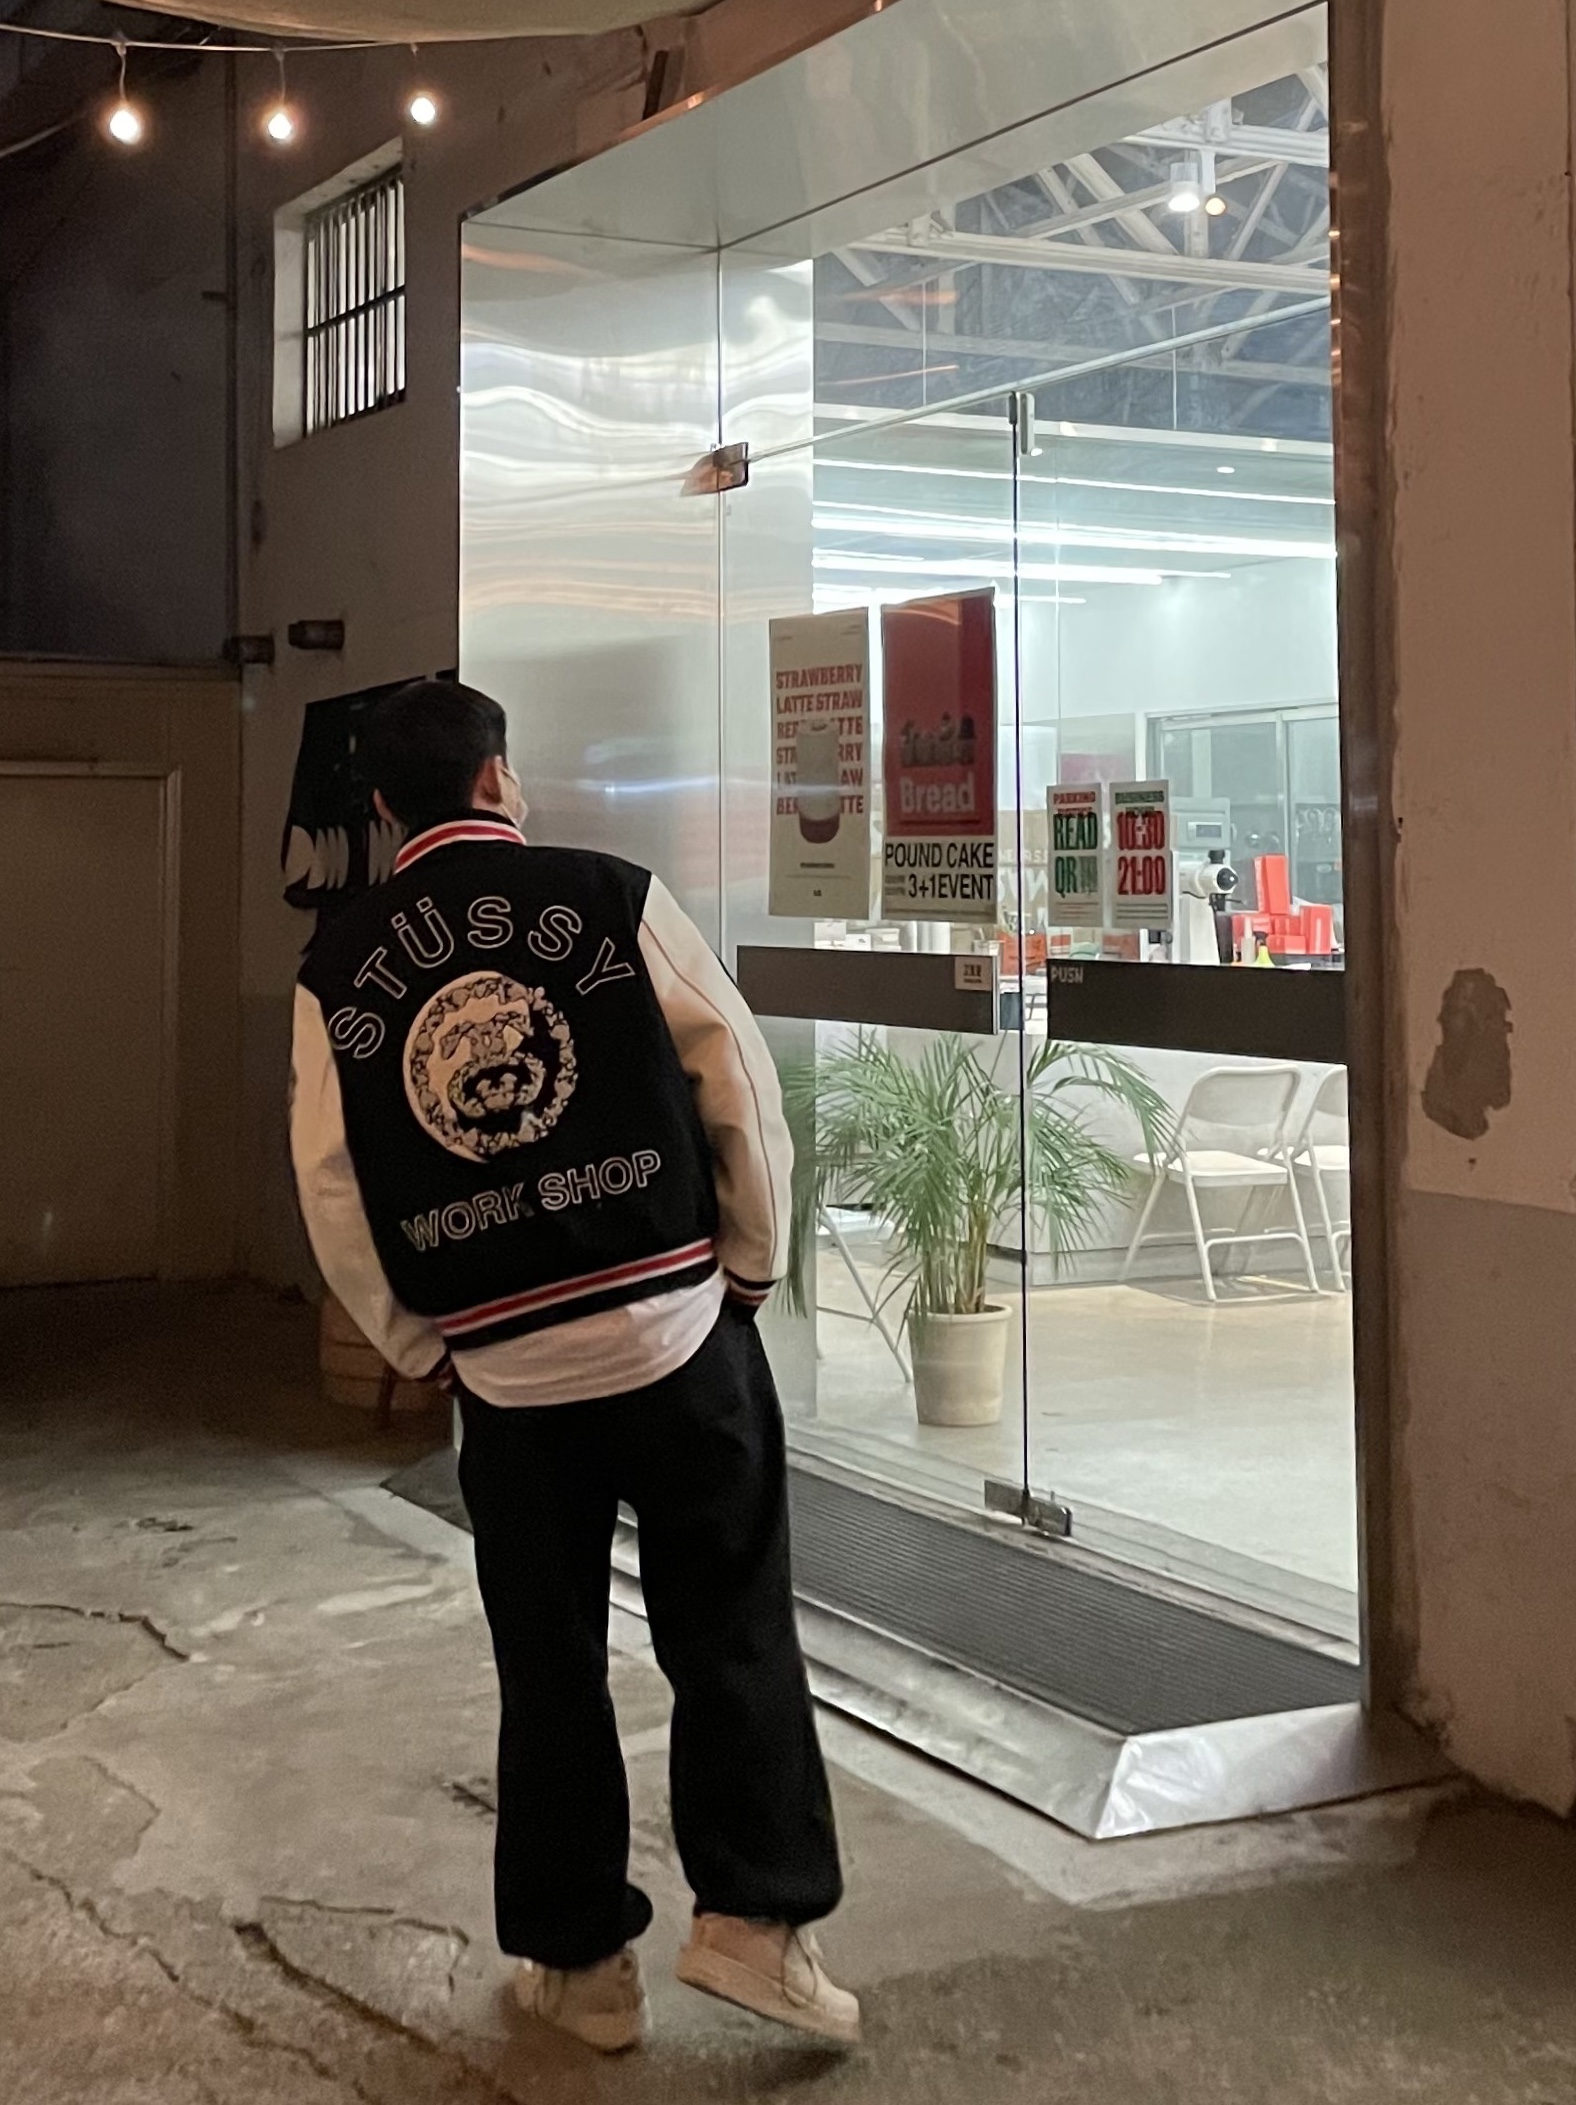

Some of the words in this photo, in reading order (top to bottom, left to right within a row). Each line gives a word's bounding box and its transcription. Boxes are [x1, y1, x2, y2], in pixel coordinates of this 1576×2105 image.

[776, 664, 863, 690] STRAWBERRY
[776, 694, 814, 715] LATTE
[816, 690, 863, 712] STRAW
[899, 770, 975, 813] Bread
[1053, 811, 1098, 850] READ
[1117, 810, 1165, 850] 10:30
[885, 843, 942, 867] POUND
[946, 843, 994, 868] CAKE
[1117, 855, 1166, 895] 21:00
[328, 897, 636, 1059] STÜSSY
[1050, 966, 1084, 983] PUSH
[401, 1182, 535, 1251] WORK
[537, 1149, 661, 1210] SHOP
